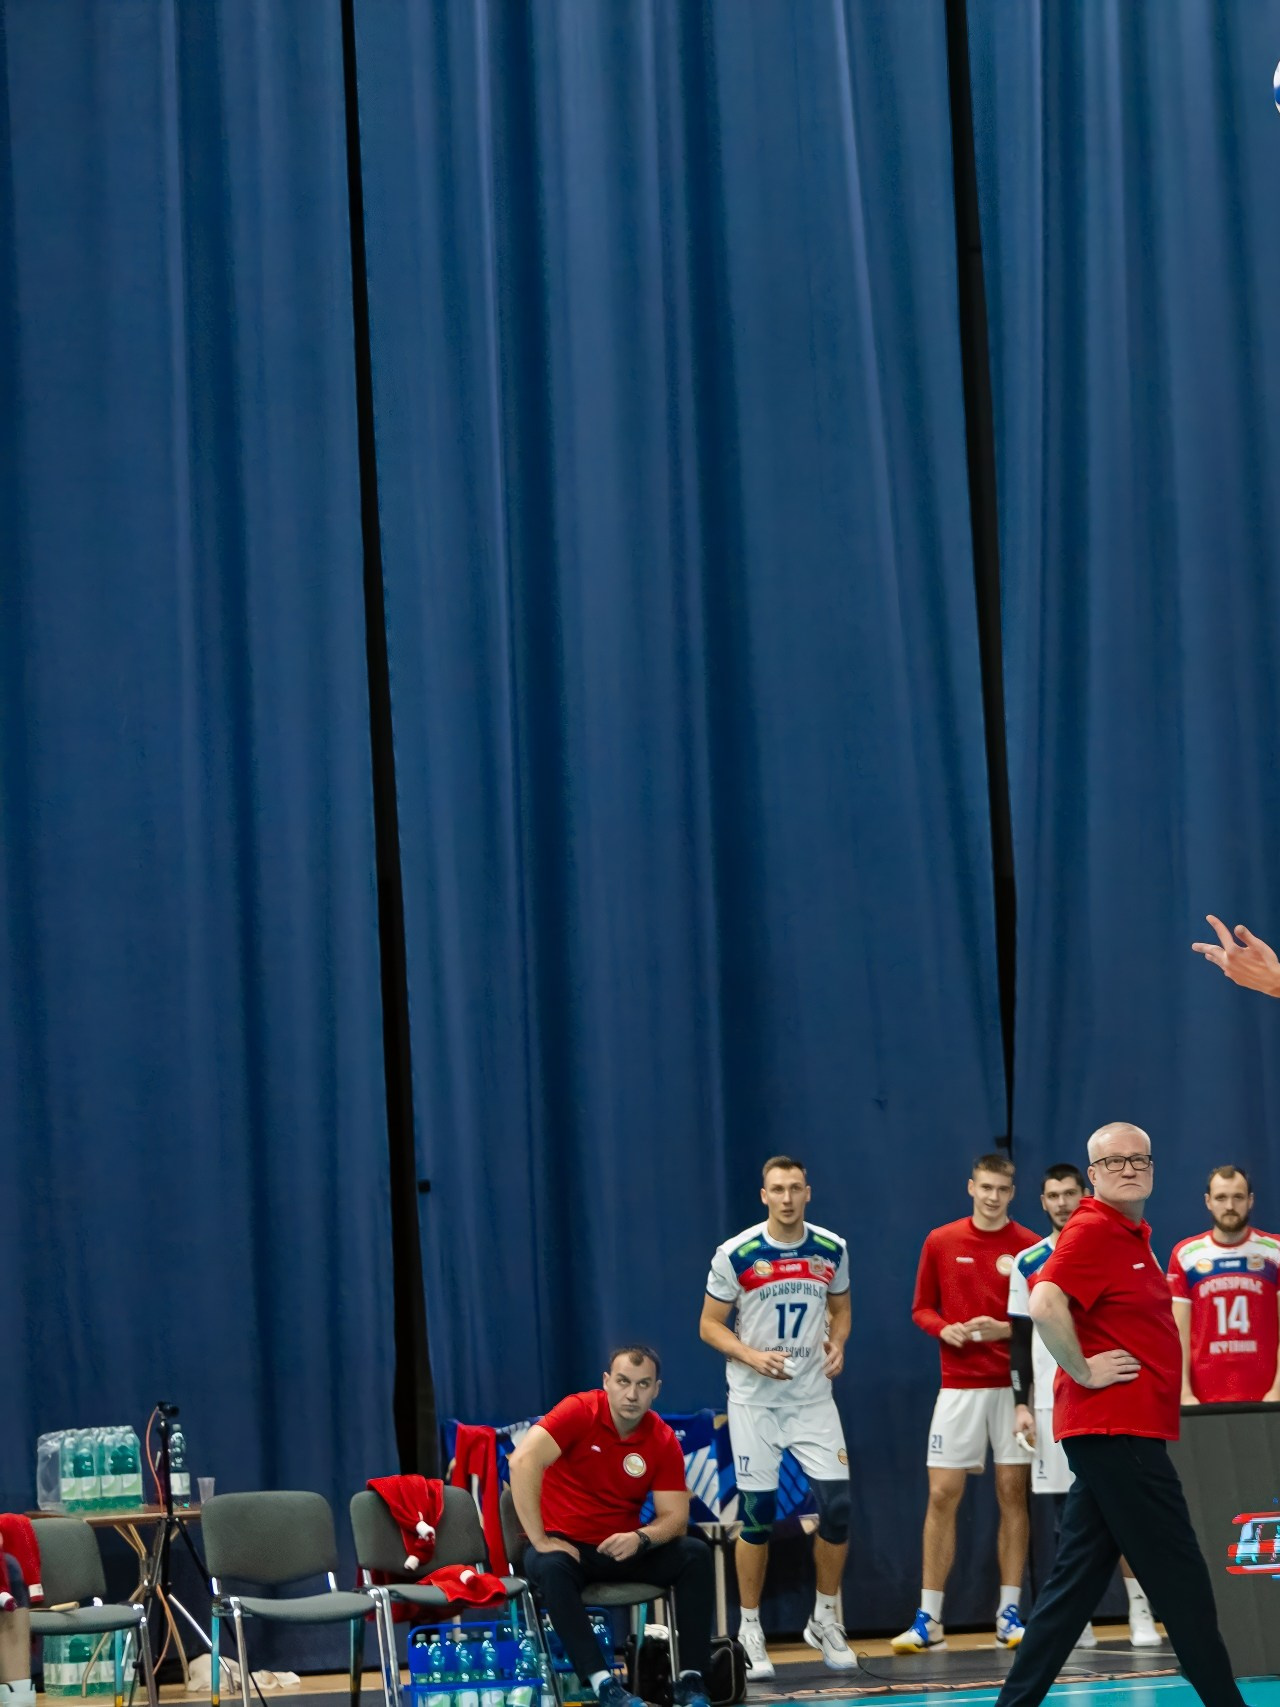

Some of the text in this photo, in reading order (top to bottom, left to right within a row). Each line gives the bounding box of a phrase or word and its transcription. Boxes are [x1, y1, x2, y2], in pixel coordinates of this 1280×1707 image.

[775, 1302, 808, 1339] 17
[1213, 1295, 1250, 1335] 14
[738, 1455, 750, 1473] 17
